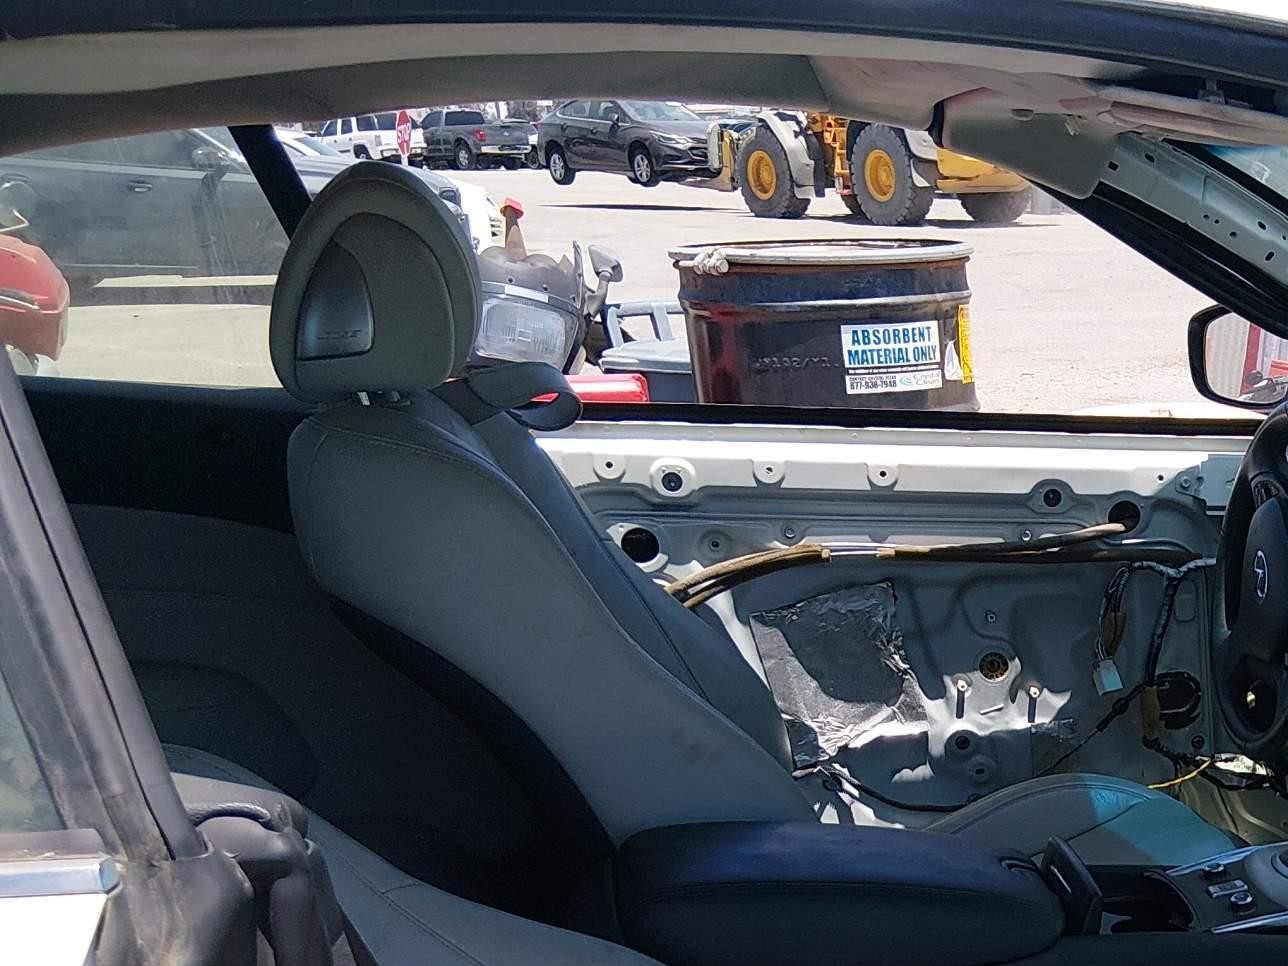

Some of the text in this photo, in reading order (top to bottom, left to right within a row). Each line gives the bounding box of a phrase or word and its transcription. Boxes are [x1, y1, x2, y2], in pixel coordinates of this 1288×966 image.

[397, 122, 411, 143] STOP
[851, 326, 932, 346] ABSORBENT
[847, 347, 911, 366] MATERIAL
[913, 345, 937, 362] ONLY
